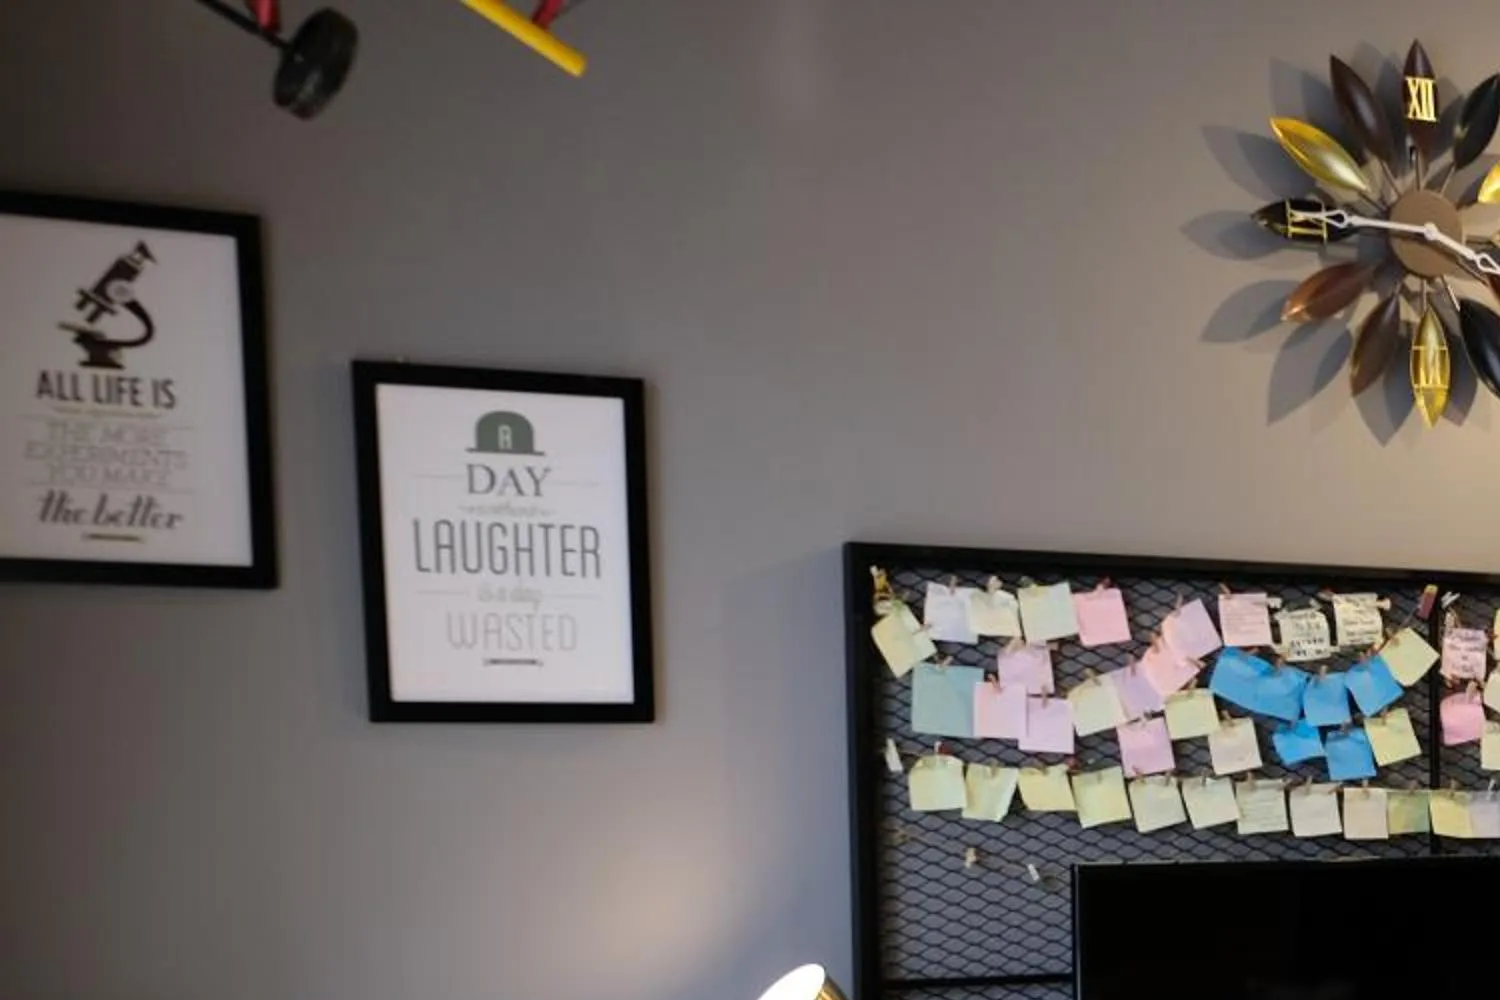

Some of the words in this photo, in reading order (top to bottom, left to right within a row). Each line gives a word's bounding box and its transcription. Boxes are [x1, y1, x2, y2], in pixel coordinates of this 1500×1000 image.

[1406, 77, 1438, 122] XII
[36, 370, 80, 401] ALL
[93, 374, 142, 408] LIFE
[152, 378, 177, 410] IS
[497, 424, 513, 450] A
[466, 462, 552, 498] DAY
[38, 488, 86, 526] the
[92, 493, 184, 530] better
[413, 518, 602, 580] LAUGHTER
[447, 611, 578, 653] WASTED
